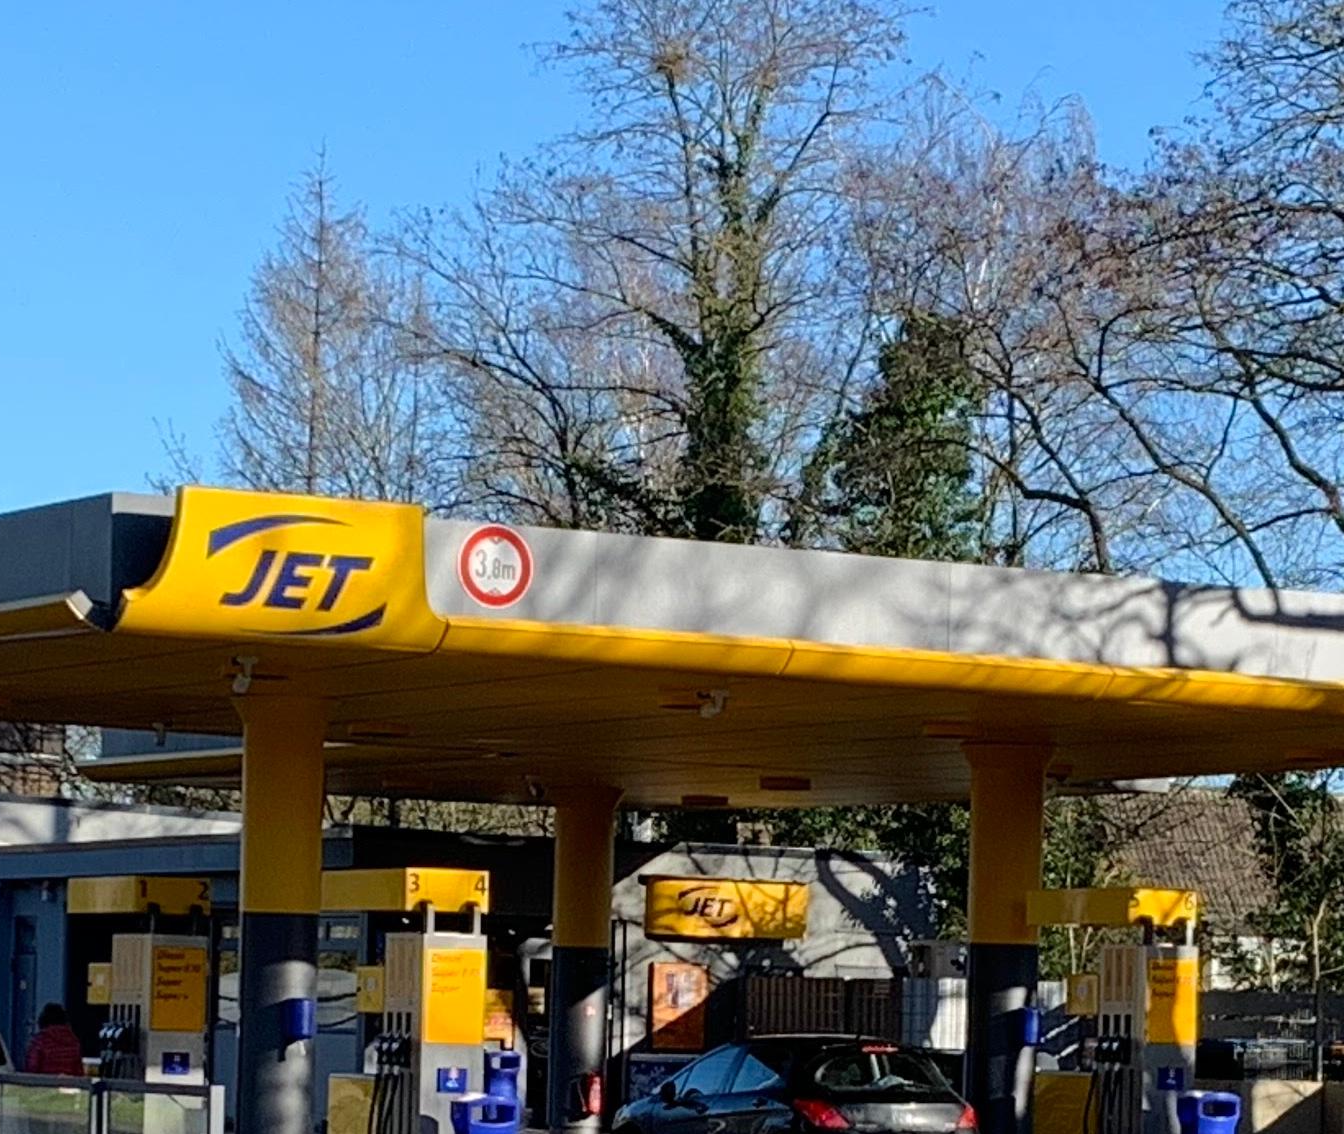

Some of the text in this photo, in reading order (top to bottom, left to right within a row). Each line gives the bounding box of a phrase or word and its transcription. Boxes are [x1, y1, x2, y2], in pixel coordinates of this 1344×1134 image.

[219, 548, 375, 612] JET
[139, 880, 149, 898] 1
[197, 880, 210, 900] 2
[408, 873, 421, 894] 3
[473, 875, 487, 897] 4
[684, 897, 733, 918] JET
